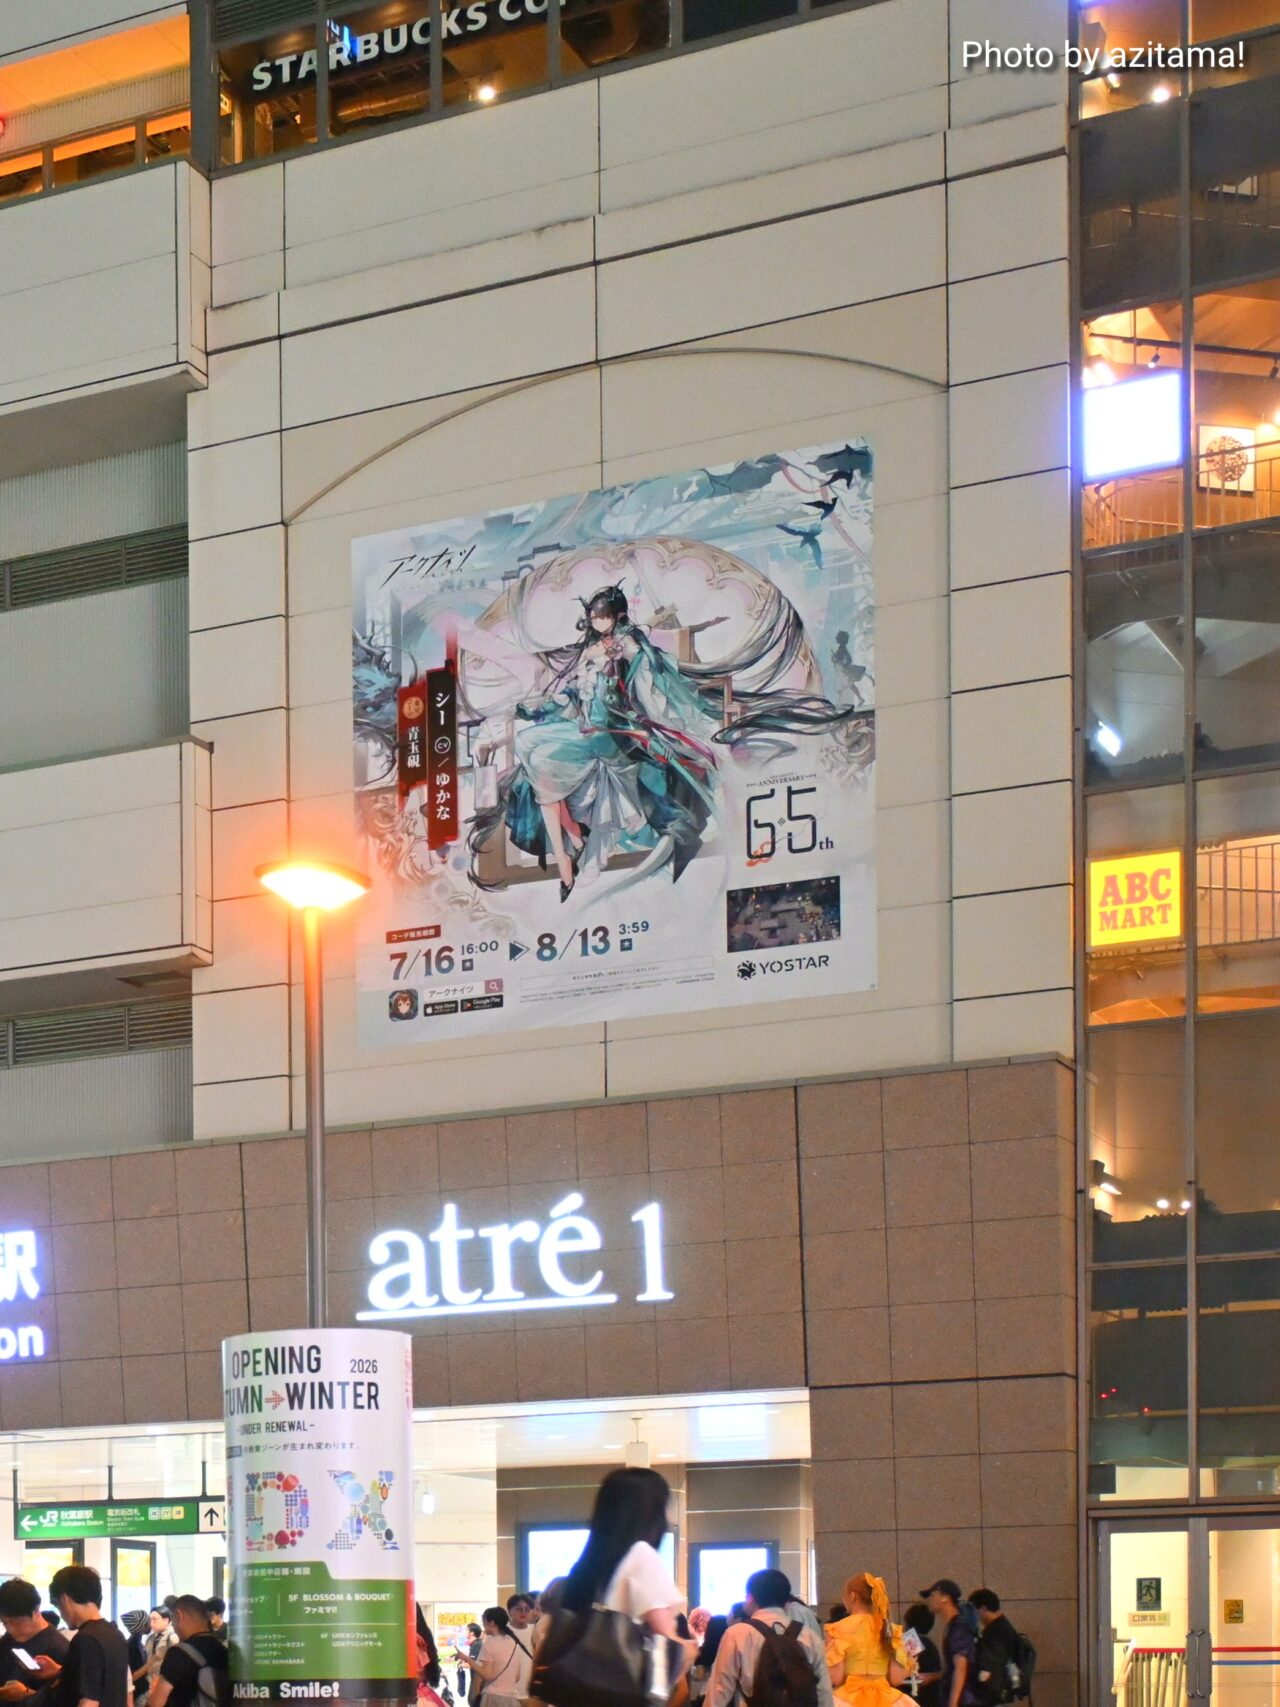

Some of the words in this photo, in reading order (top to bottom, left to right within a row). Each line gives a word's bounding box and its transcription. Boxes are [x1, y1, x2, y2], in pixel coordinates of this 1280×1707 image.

[252, 1, 488, 91] STARBUCKS
[498, 0, 566, 21] CO
[758, 775, 804, 787] ANNIVERSARY
[435, 774, 451, 820] ゆかな
[1098, 868, 1172, 908] ABC
[1098, 903, 1172, 932] MART
[536, 926, 611, 962] 8/13
[619, 920, 650, 935] 3:59
[389, 945, 455, 981] 7/16
[461, 940, 499, 955] 16:00
[759, 955, 830, 975] YOSTAR
[428, 985, 474, 998] アークナイツ
[368, 1193, 604, 1310] atré
[631, 1201, 675, 1302] 1
[232, 1344, 322, 1379] OPENING
[349, 1359, 378, 1374] 2026
[285, 1381, 380, 1411] WINTER
[39, 1510, 59, 1524] JR
[302, 1593, 344, 1601] BLOSSOM
[354, 1592, 391, 1601] BOUQUET
[233, 1683, 270, 1699] Akiba
[280, 1681, 340, 1699] Smile!
